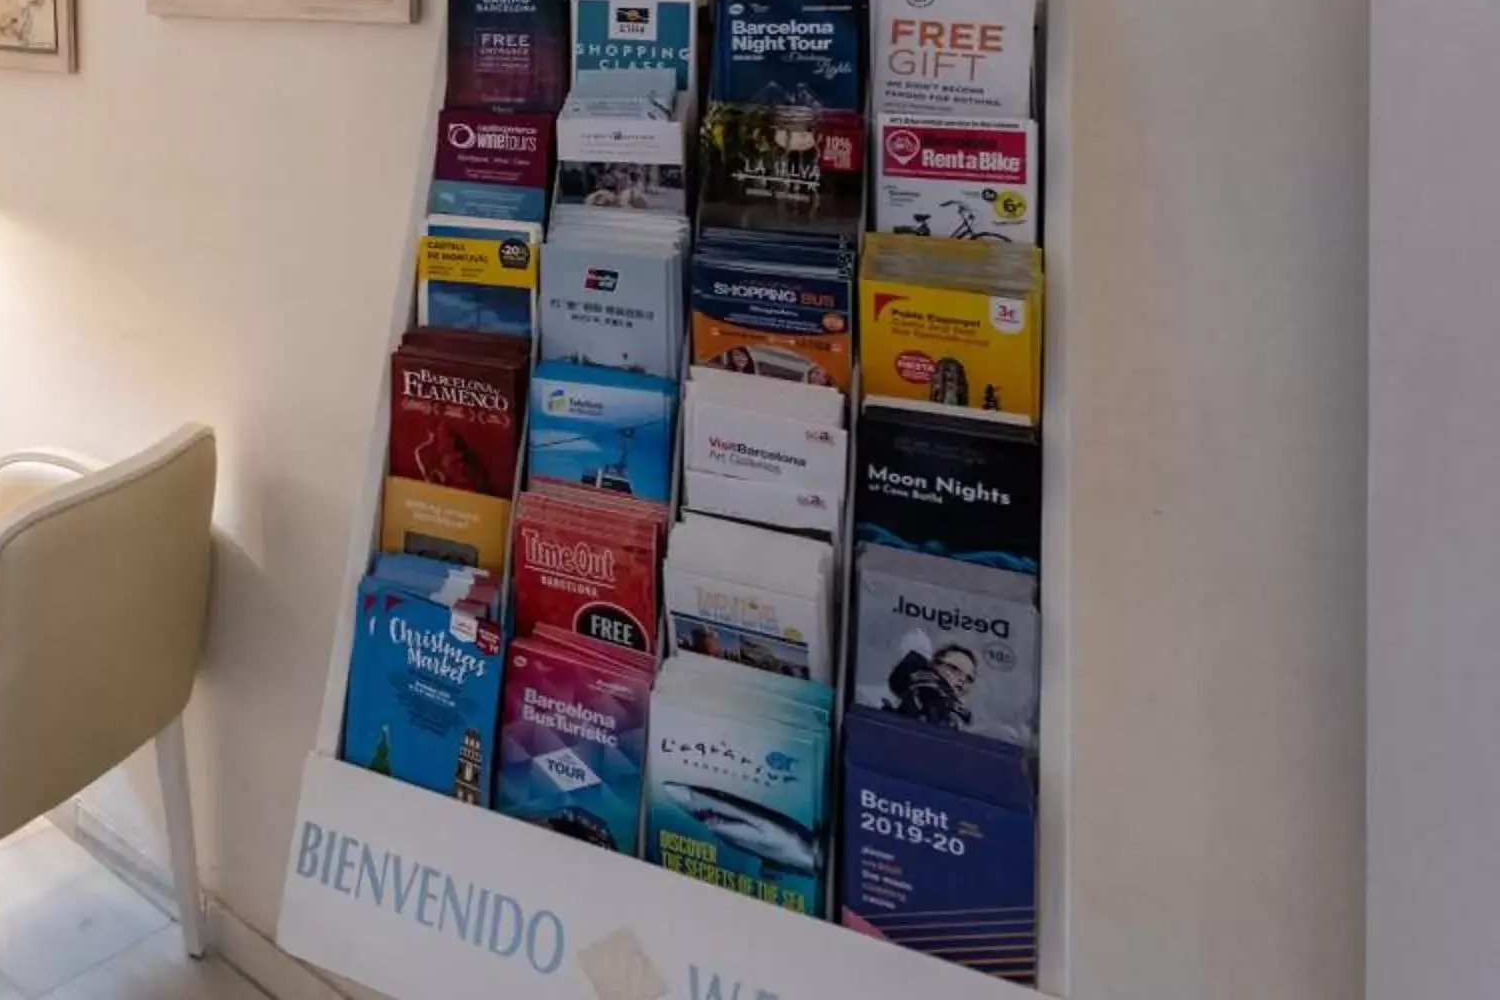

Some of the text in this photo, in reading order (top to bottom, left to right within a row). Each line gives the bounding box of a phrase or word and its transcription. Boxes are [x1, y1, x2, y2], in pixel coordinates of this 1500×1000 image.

[480, 33, 530, 48] FREE
[731, 18, 835, 36] Barcelona
[731, 35, 833, 54] Night Tour
[891, 18, 1006, 52] FREE
[888, 49, 987, 81] GIFT
[713, 281, 797, 303] SHOPPING
[403, 371, 509, 411] FLAMENCO
[420, 369, 494, 393] BARCELONA
[867, 463, 1011, 505] Moon Nights
[388, 616, 487, 678] Christmas
[591, 614, 634, 646] FREE
[407, 647, 467, 685] Market
[523, 687, 616, 731] Barcelona
[547, 758, 586, 783] TOUR
[860, 788, 950, 831] Bcnight
[659, 828, 718, 864] DISCOVER
[860, 812, 965, 856] 2019-20
[296, 819, 566, 974] BIENVENIDO
